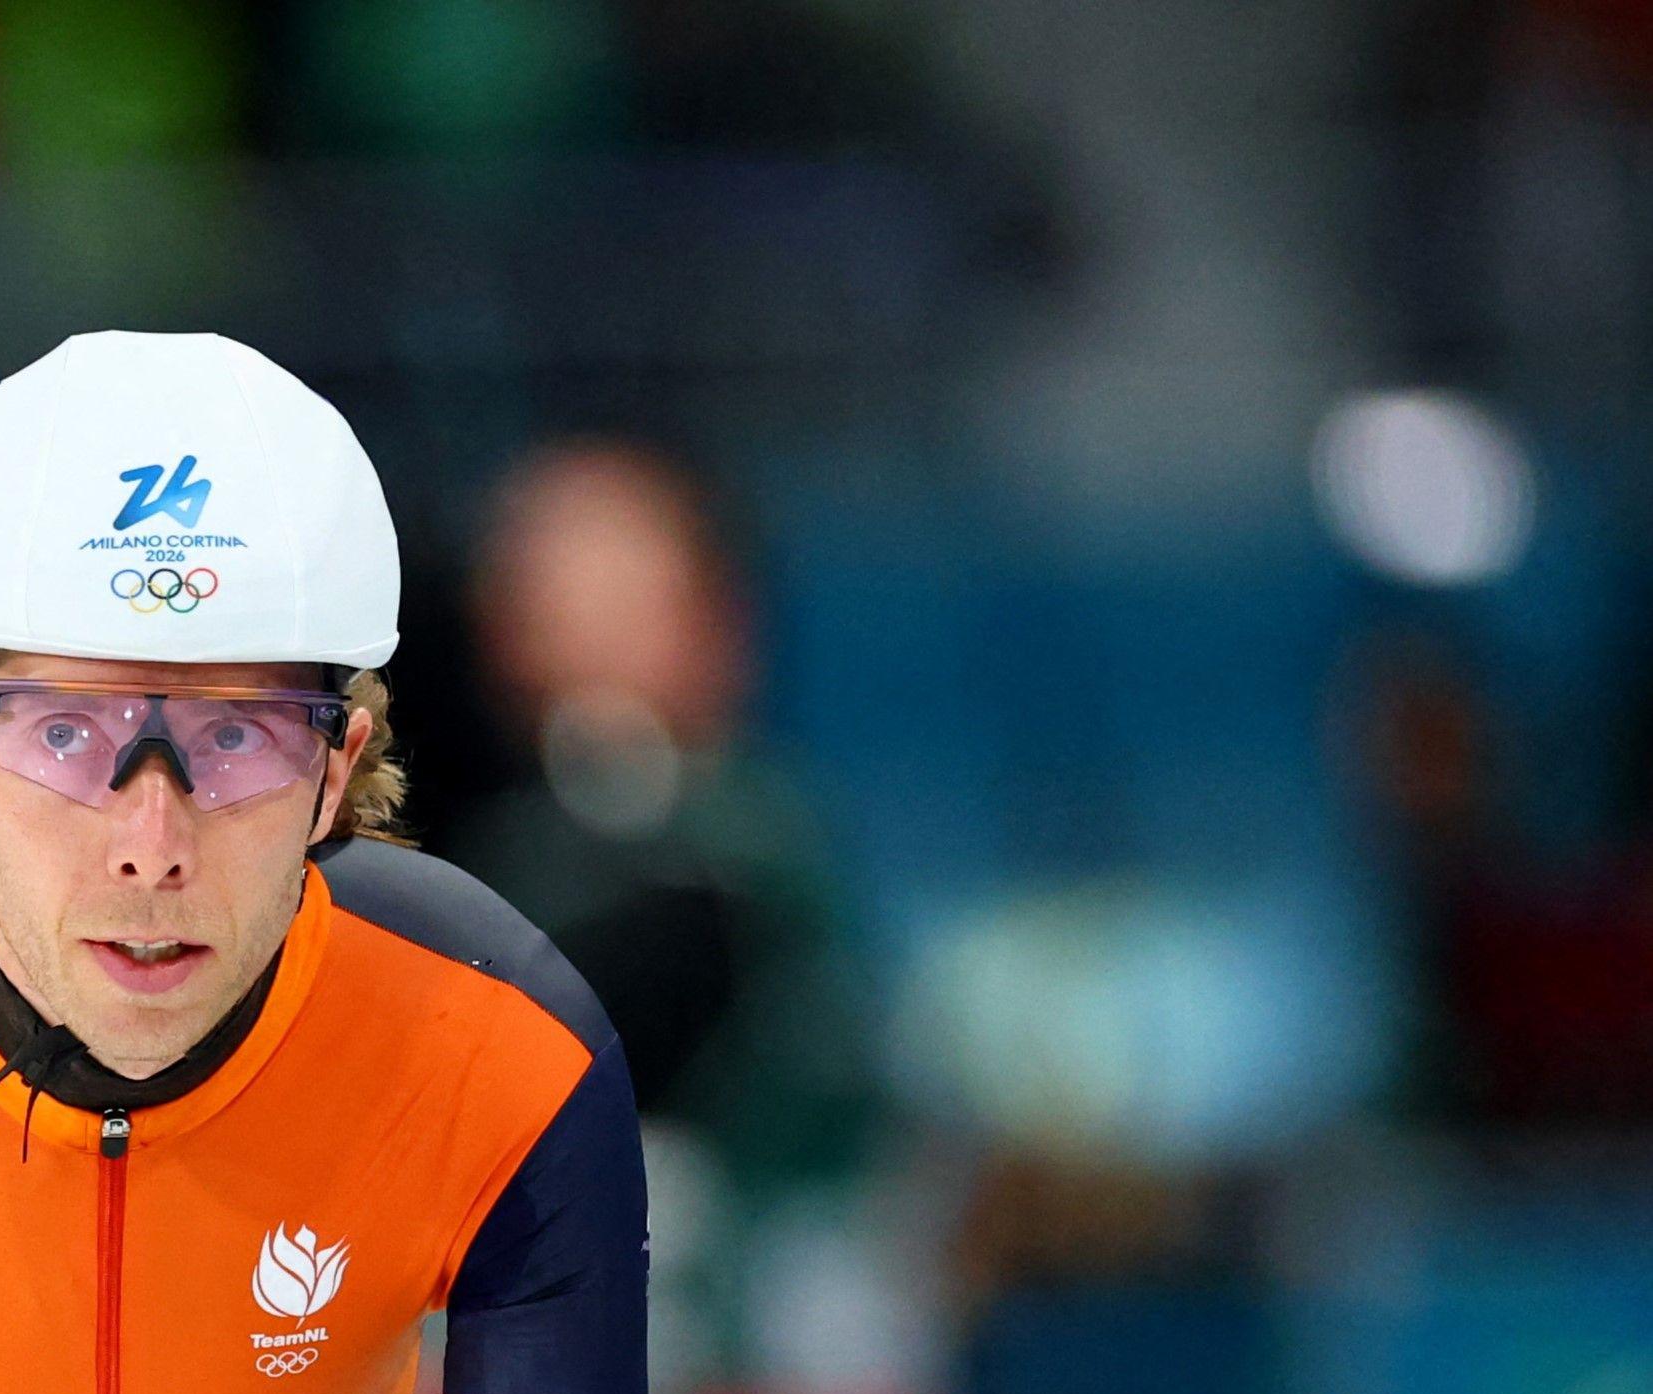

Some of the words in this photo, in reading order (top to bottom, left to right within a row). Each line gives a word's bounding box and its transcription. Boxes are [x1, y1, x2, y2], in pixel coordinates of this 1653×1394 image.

[79, 535, 162, 550] MILANO
[166, 535, 248, 548] CORTINA
[145, 550, 185, 562] 2026
[250, 1327, 329, 1349] TeamNL
